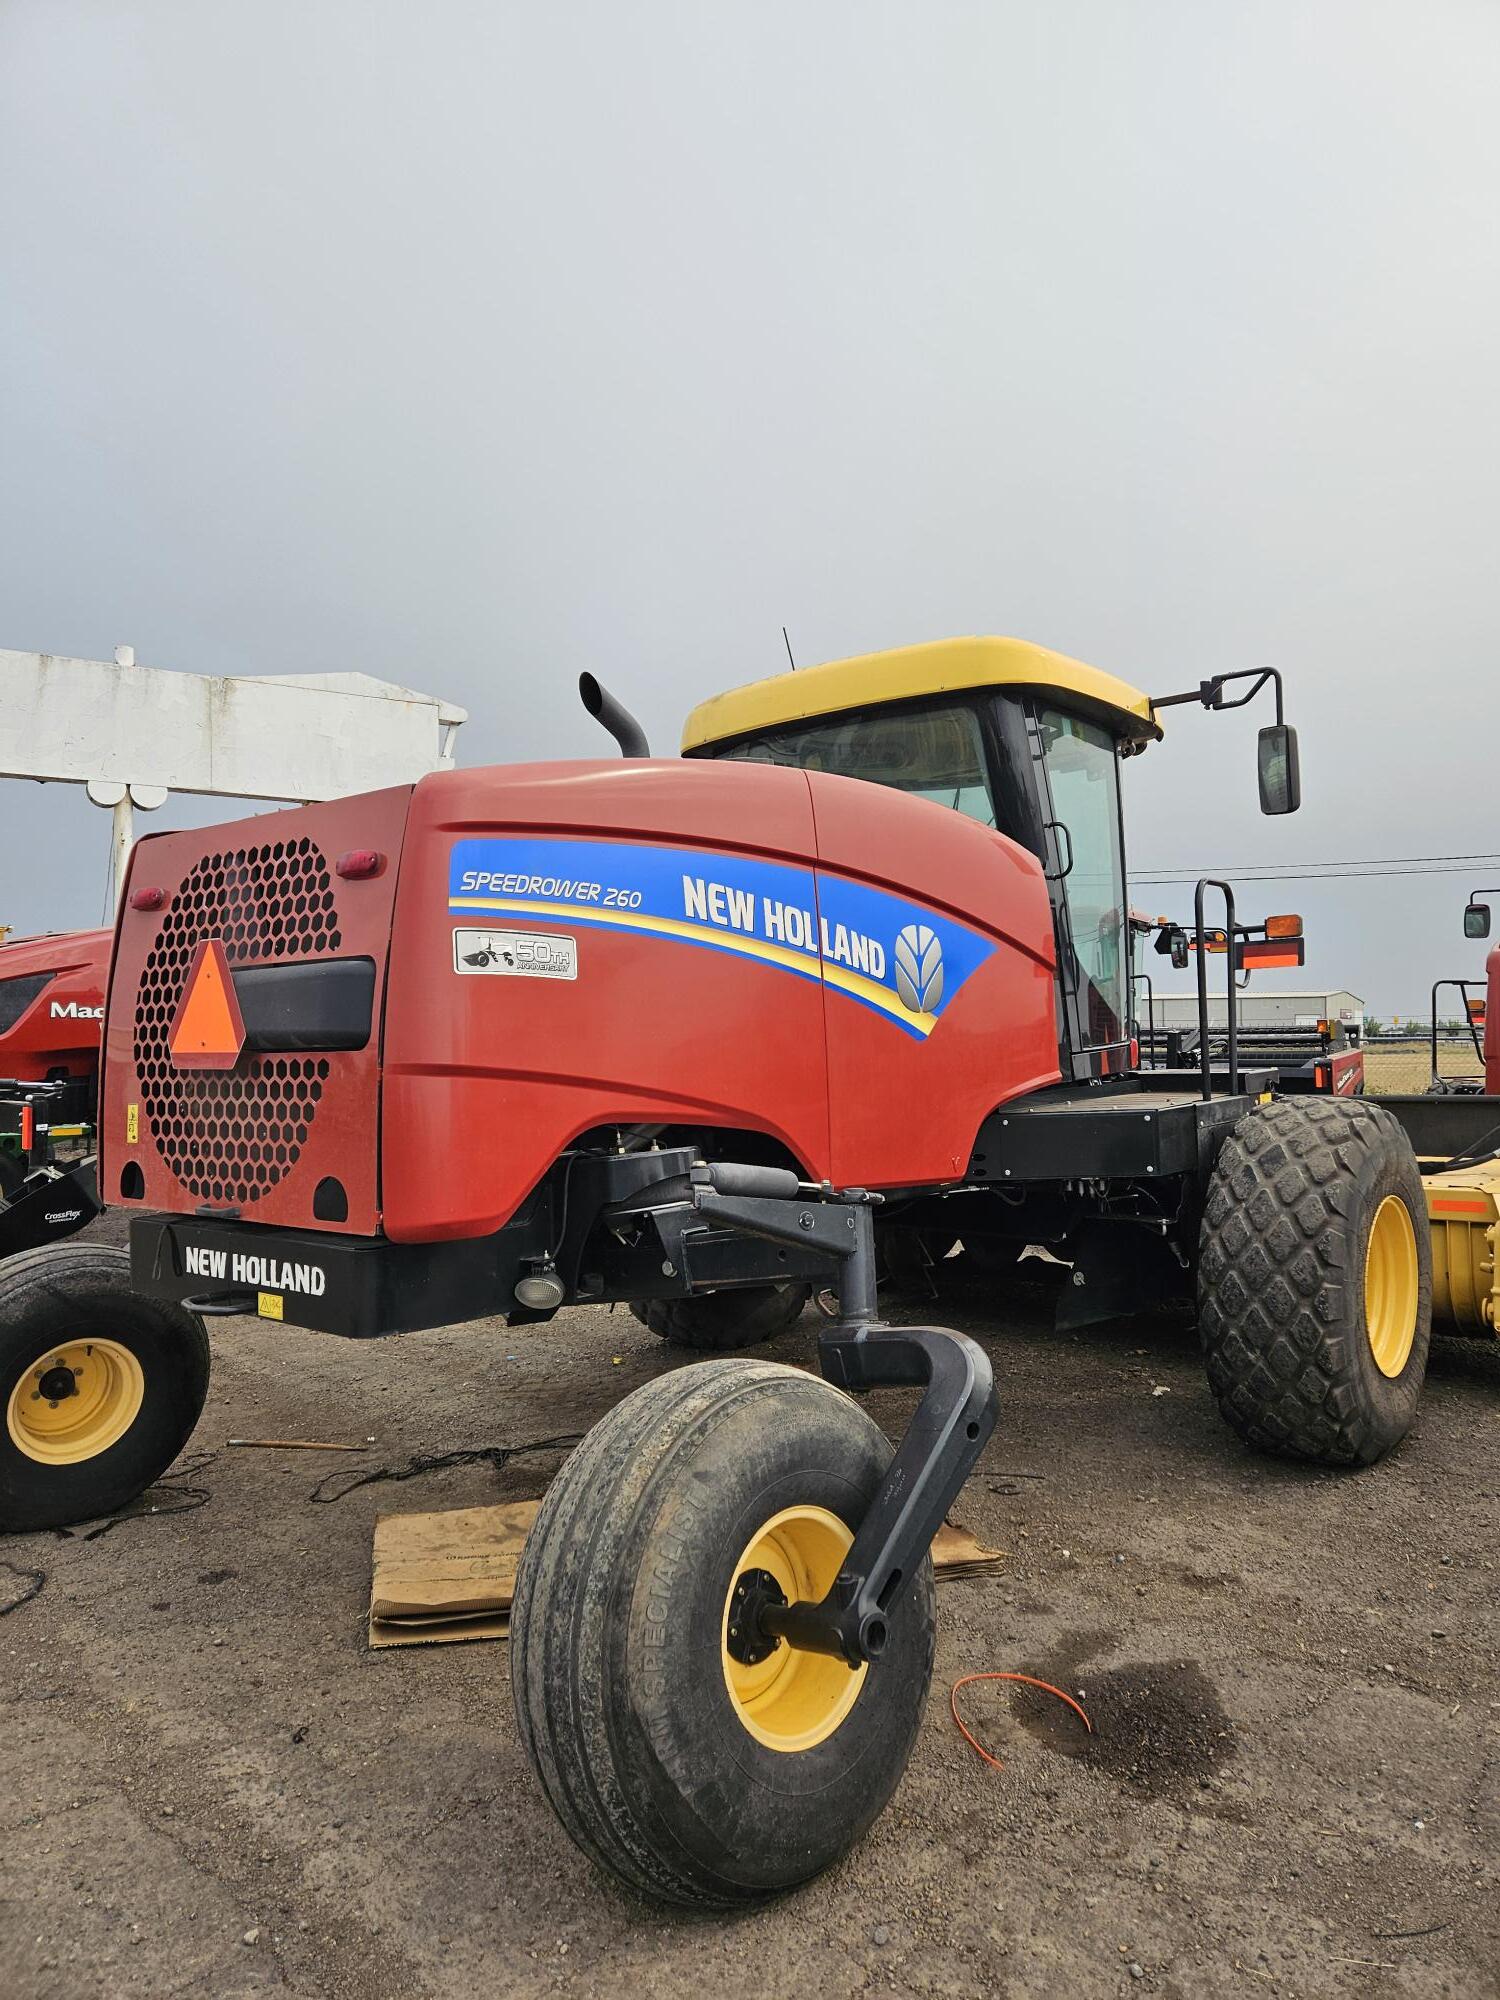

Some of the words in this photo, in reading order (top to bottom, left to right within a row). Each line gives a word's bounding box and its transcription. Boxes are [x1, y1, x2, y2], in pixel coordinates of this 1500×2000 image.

[460, 872, 601, 901] SPEEDROWER
[603, 888, 642, 908] 260
[682, 875, 755, 933] NEW
[763, 897, 886, 979] HOLLAND
[185, 1246, 227, 1279] NEW
[232, 1253, 326, 1296] HOLLAND
